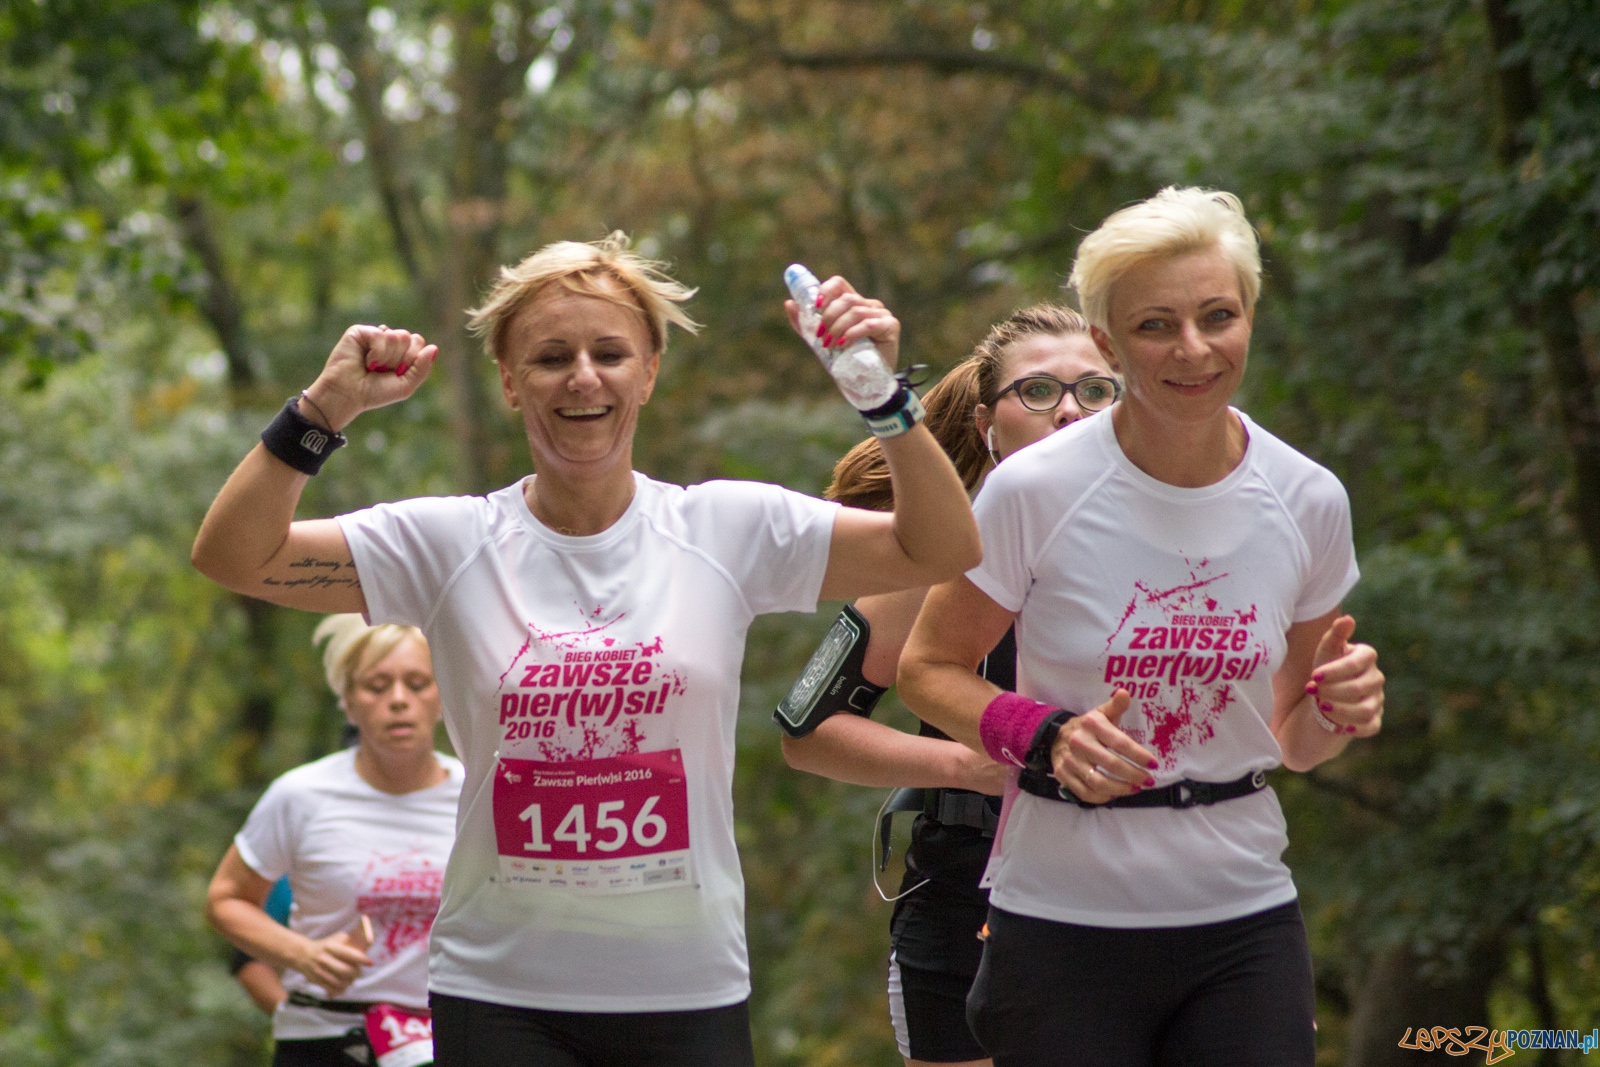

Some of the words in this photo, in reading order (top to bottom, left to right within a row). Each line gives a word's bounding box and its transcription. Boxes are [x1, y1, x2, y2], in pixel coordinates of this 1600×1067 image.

[1171, 615, 1196, 626] BIEG
[1197, 615, 1236, 627] KOBIET
[1128, 626, 1248, 652] zawsze
[564, 651, 592, 663] BIEG
[594, 649, 638, 662] KOBIET
[519, 661, 653, 687] zawsze
[504, 721, 556, 741] 2016
[533, 775, 574, 787] Zawsze
[576, 772, 622, 787] Pier(w)si
[624, 768, 653, 782] 2016
[518, 795, 668, 853] 1456
